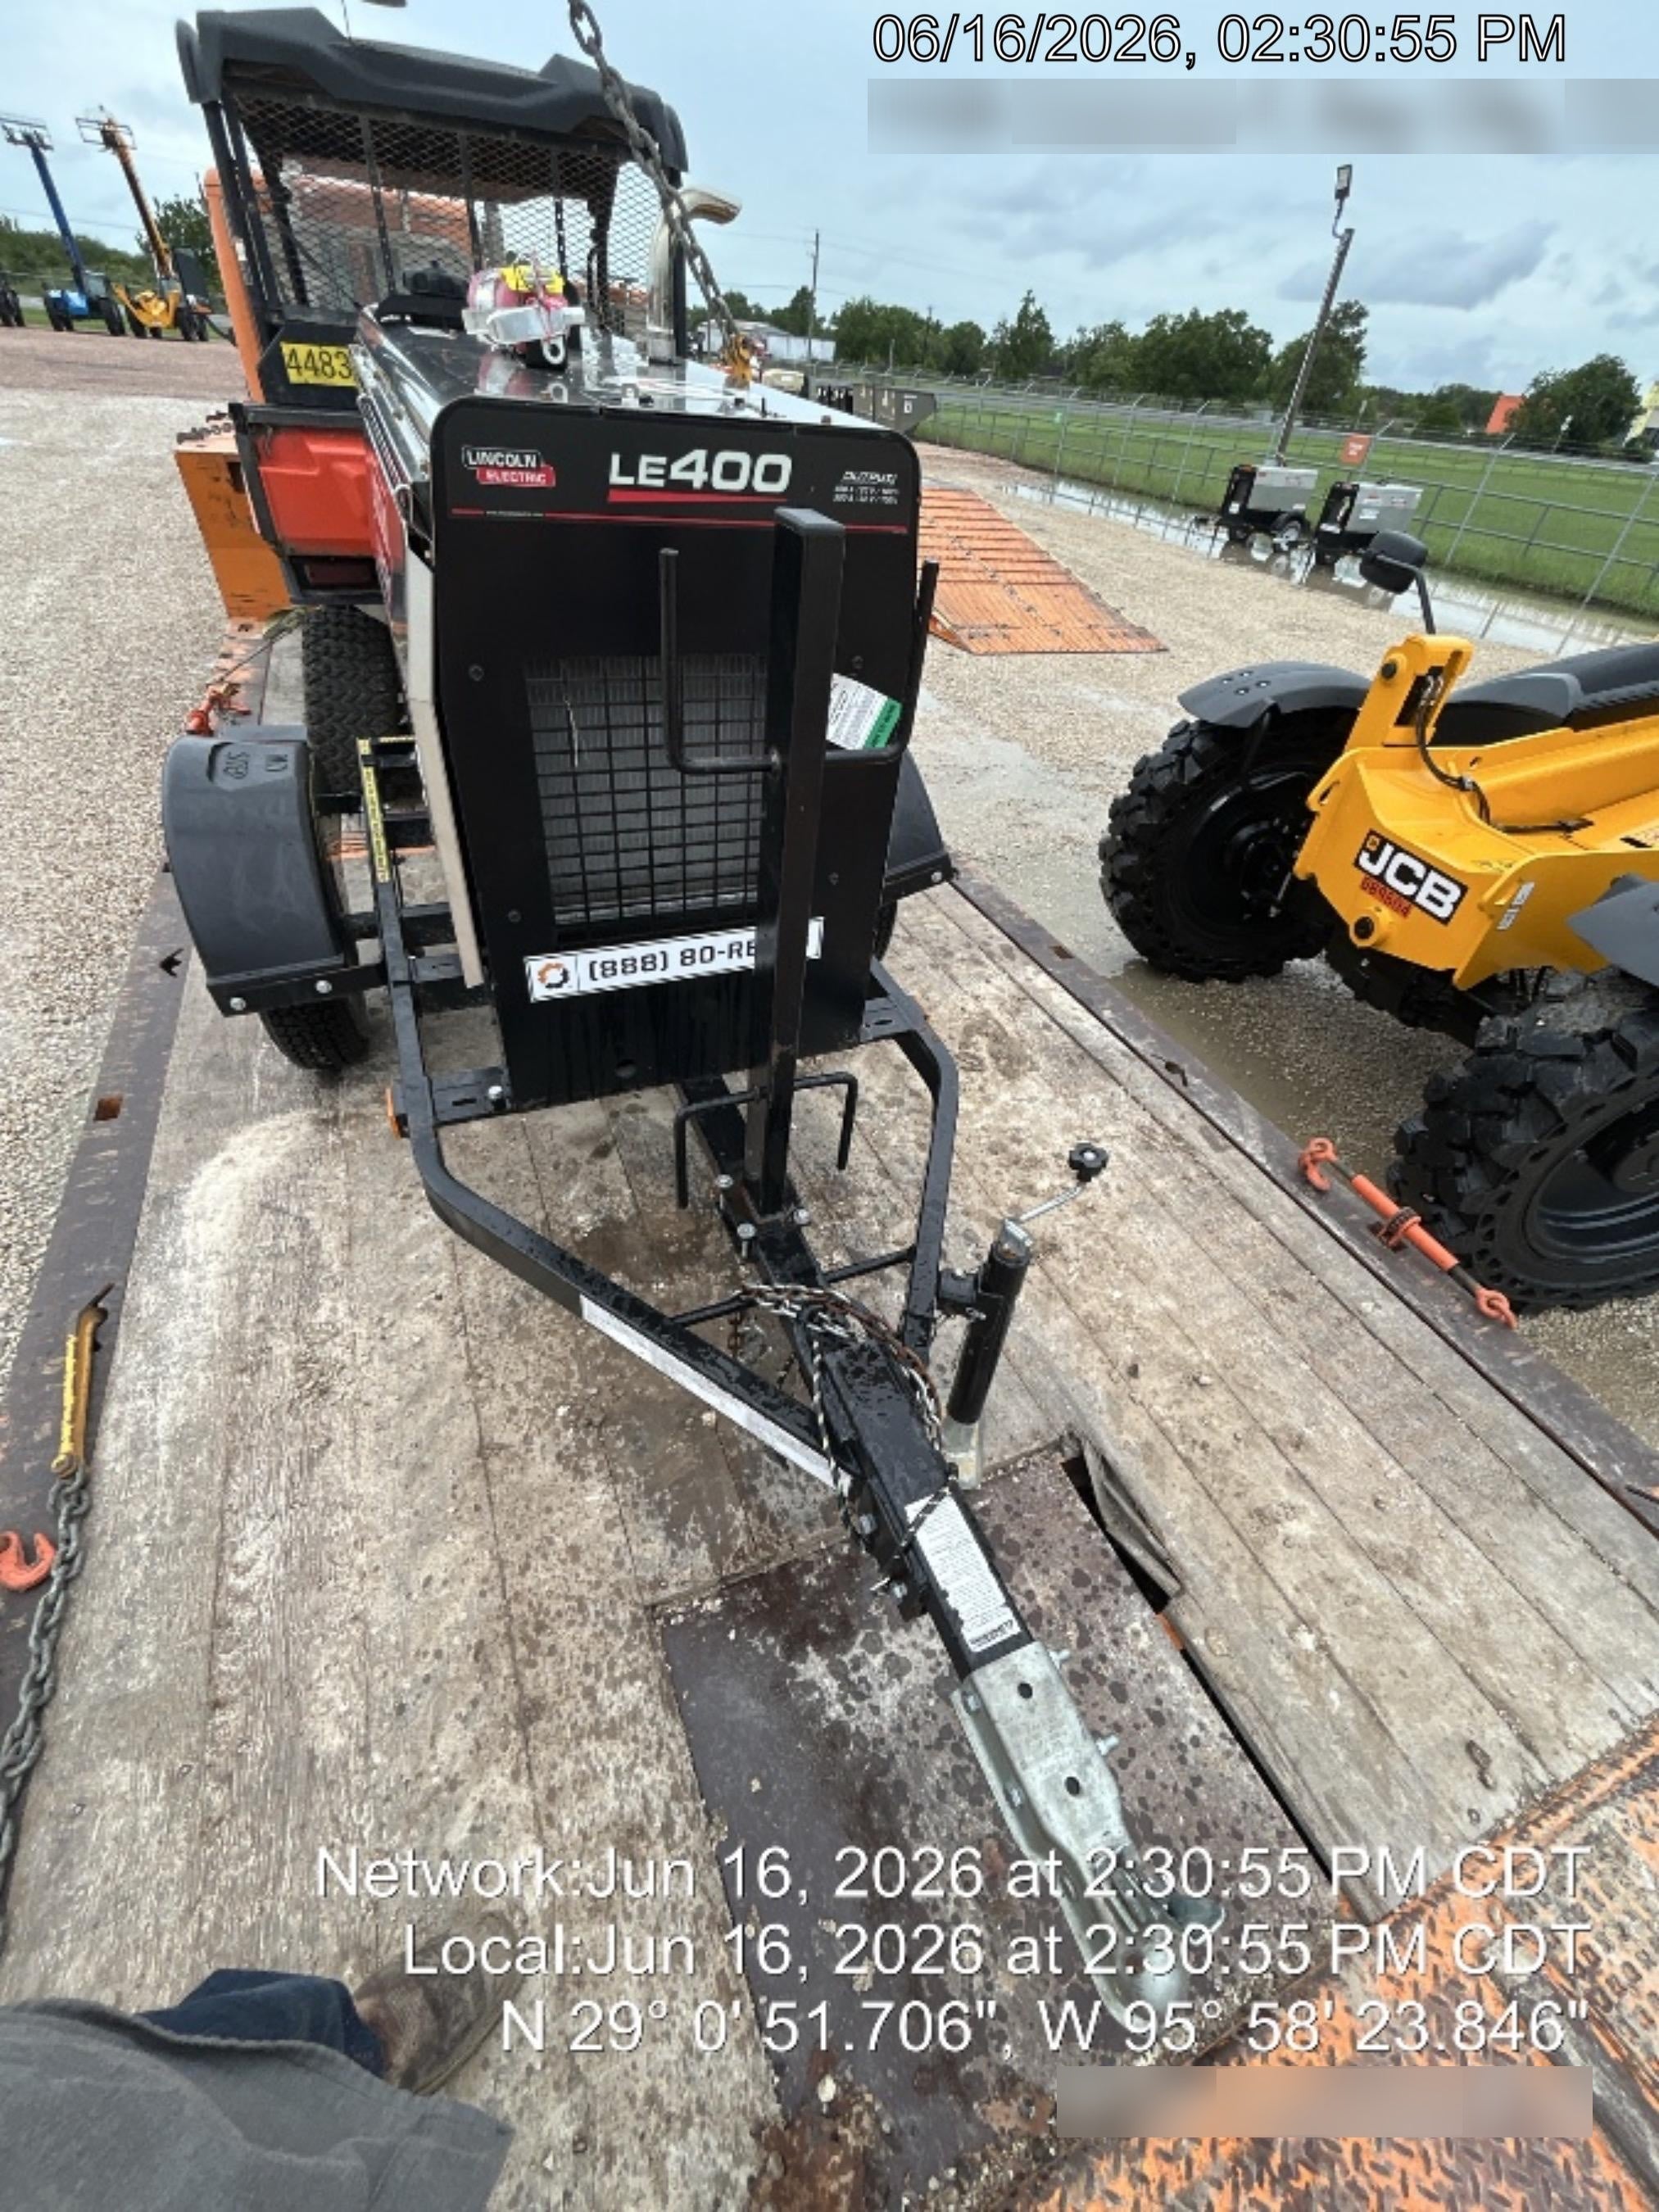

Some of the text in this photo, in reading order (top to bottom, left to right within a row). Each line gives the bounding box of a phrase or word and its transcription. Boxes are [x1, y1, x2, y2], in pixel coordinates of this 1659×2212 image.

[286, 347, 352, 379] 4483
[466, 450, 537, 469] LINCOLN
[609, 448, 793, 493] LE400
[1358, 842, 1462, 919] JCB
[588, 950, 669, 981] (888)
